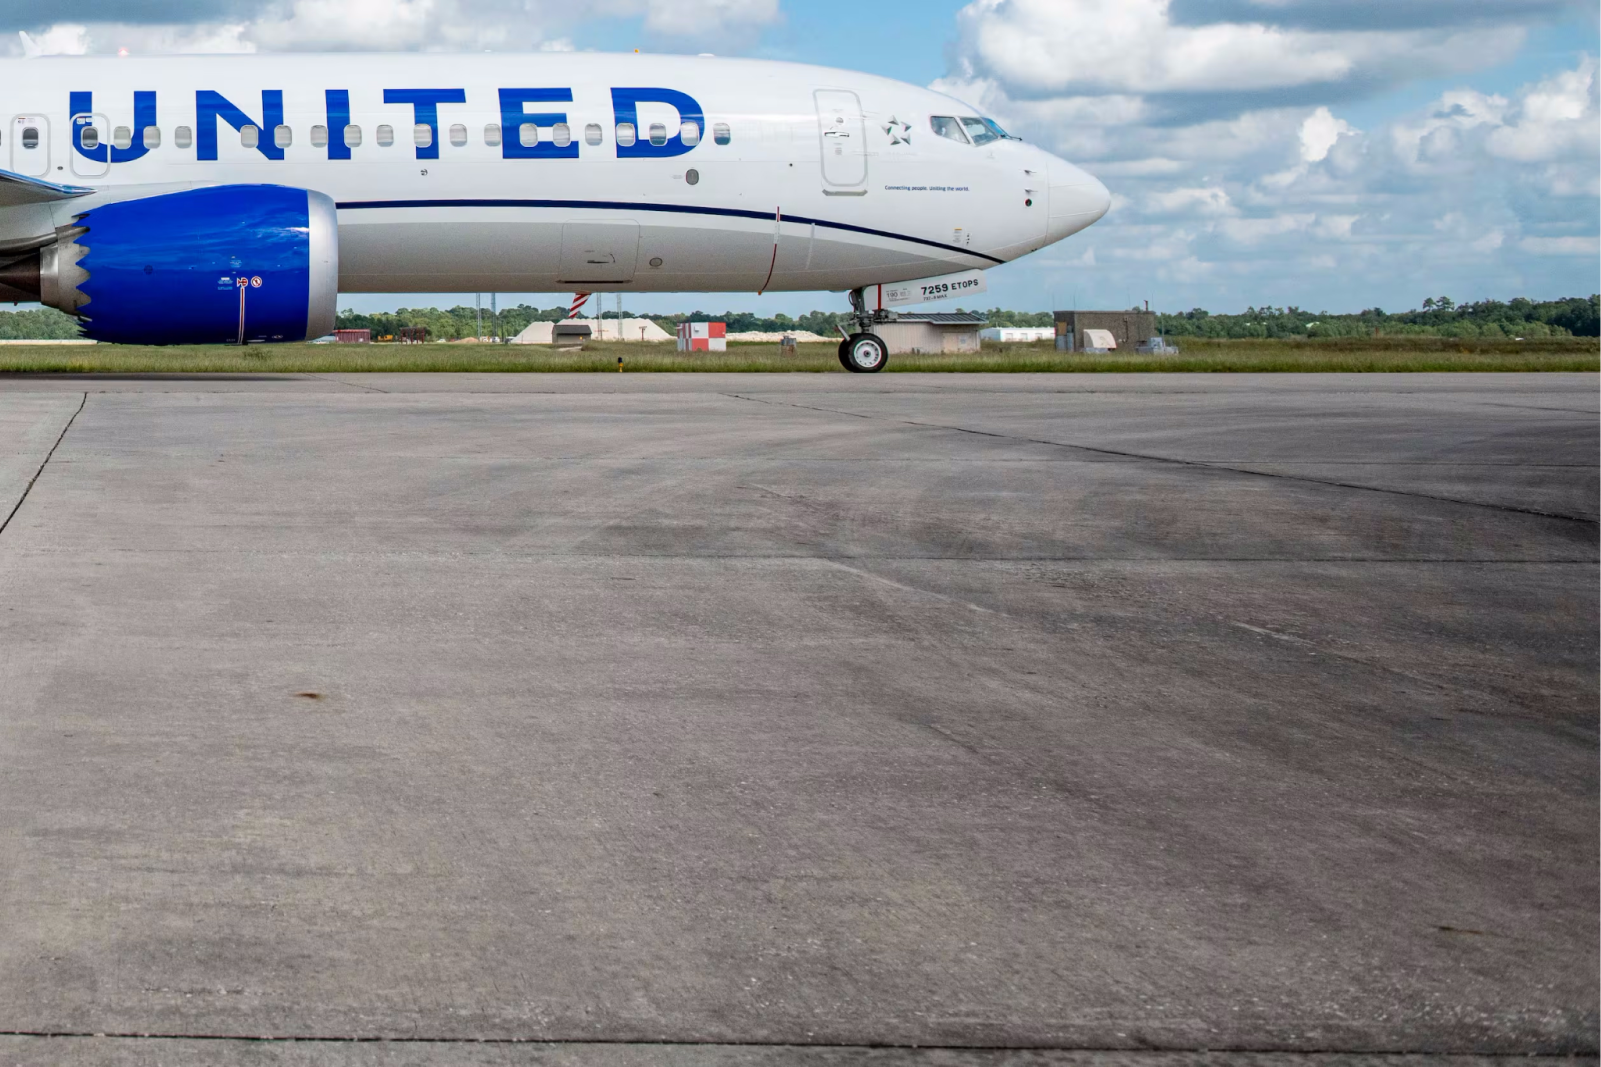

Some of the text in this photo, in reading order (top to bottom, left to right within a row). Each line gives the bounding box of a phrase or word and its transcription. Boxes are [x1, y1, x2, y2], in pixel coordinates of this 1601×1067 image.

[69, 87, 706, 163] UNITED
[921, 283, 949, 295] 7259
[951, 279, 979, 290] ETOPS
